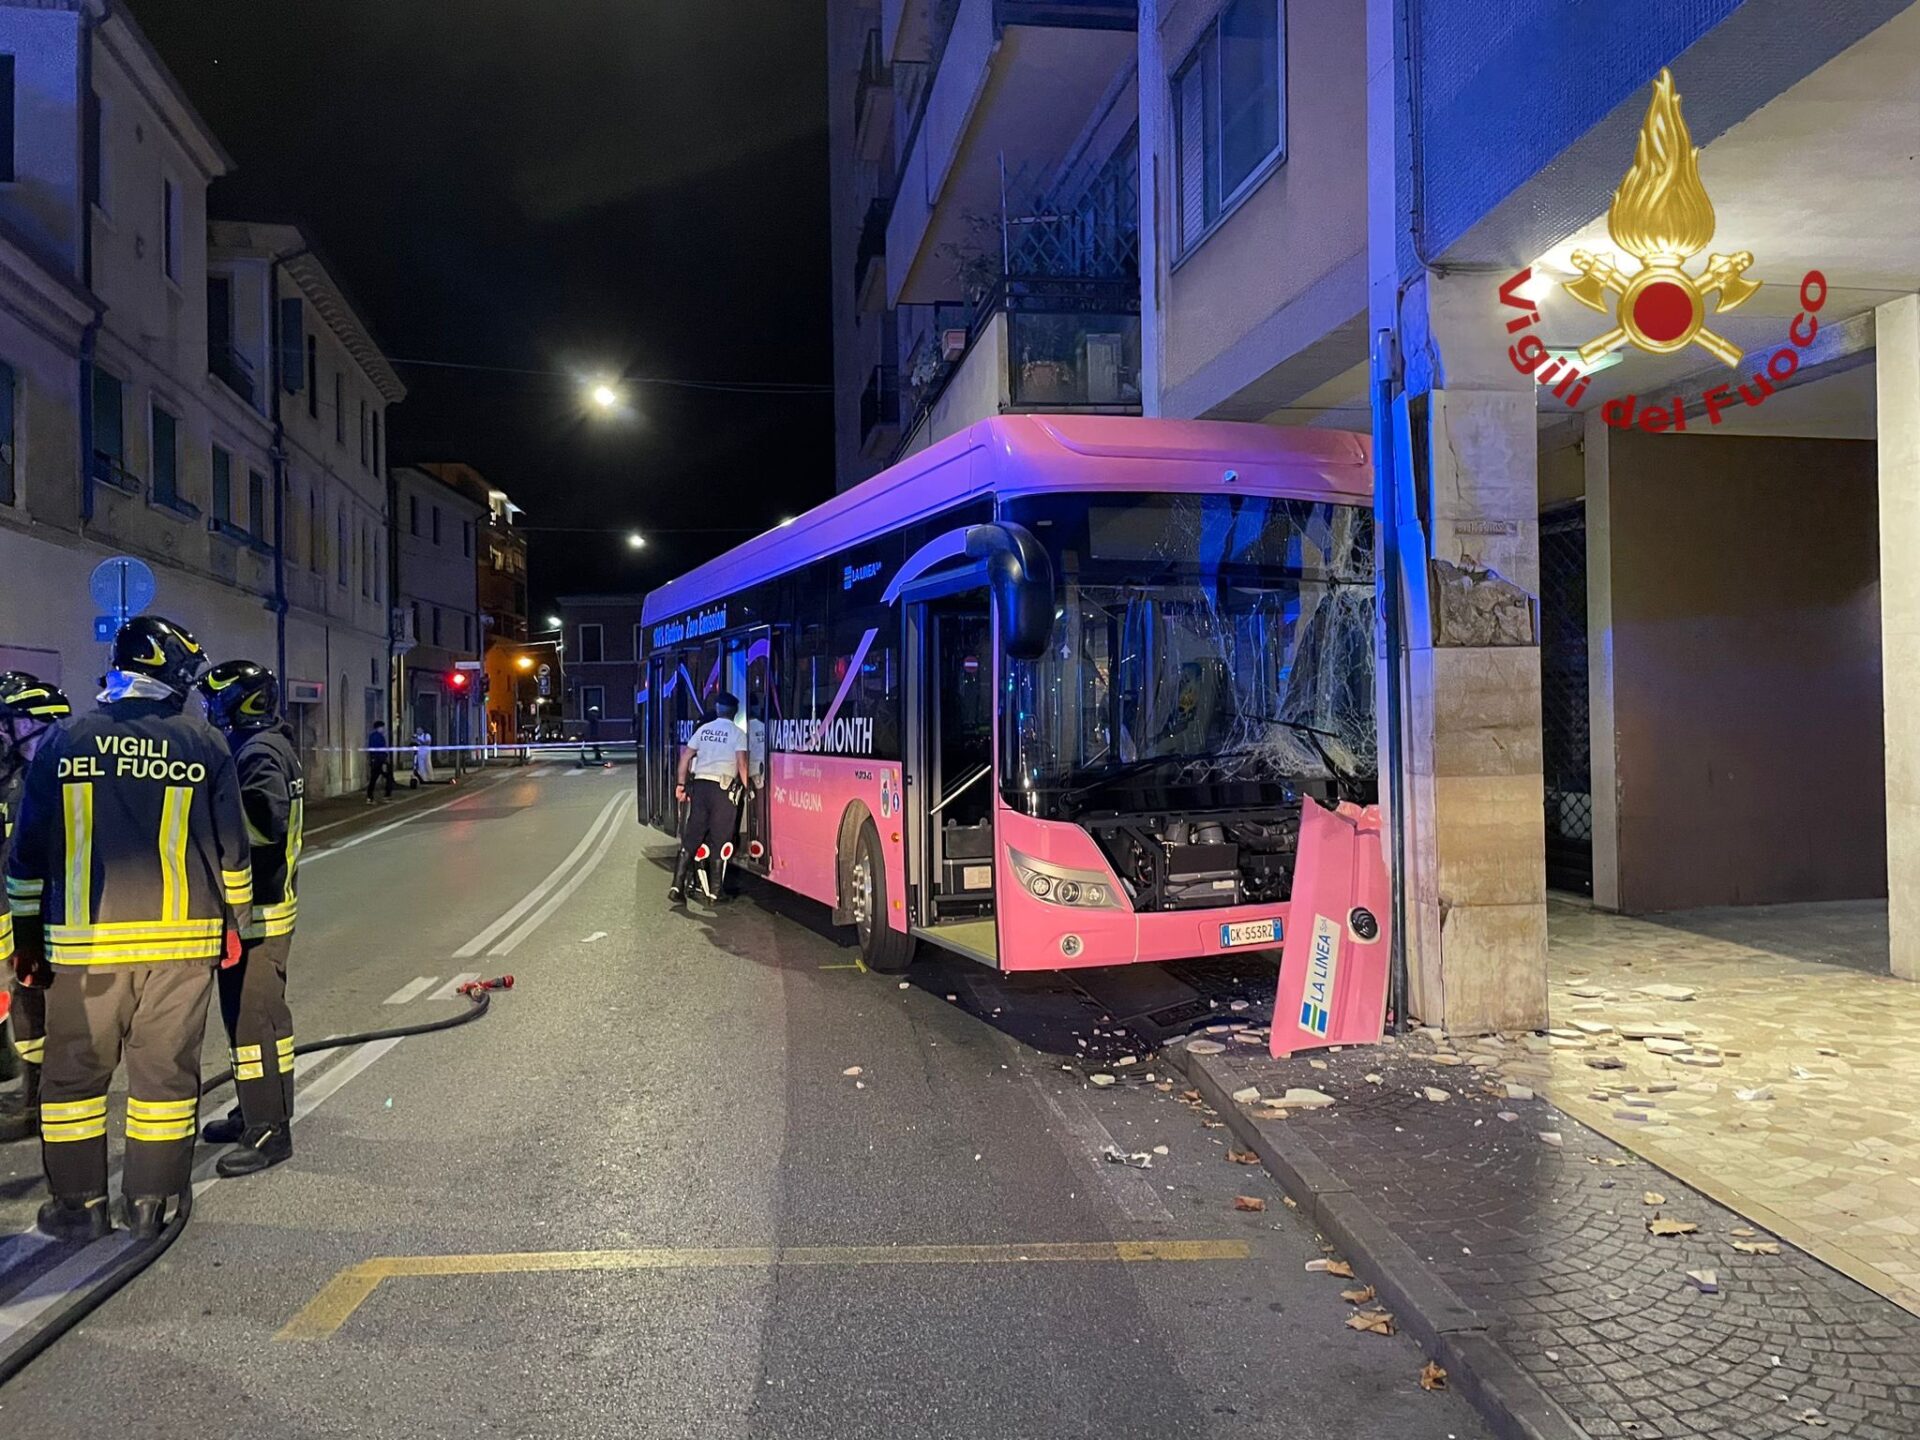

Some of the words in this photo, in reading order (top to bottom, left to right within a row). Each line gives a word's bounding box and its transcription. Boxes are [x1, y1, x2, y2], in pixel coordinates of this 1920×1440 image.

[686, 615, 698, 639] Zero
[701, 729, 728, 737] POLIZIA
[701, 736, 728, 744] LOCALE
[824, 717, 873, 754] MONTH
[95, 735, 168, 758] VIGILI
[57, 756, 105, 778] DEL
[117, 757, 206, 783] FUOCO
[1314, 934, 1331, 979] LINEA
[1310, 982, 1325, 1002] LA
